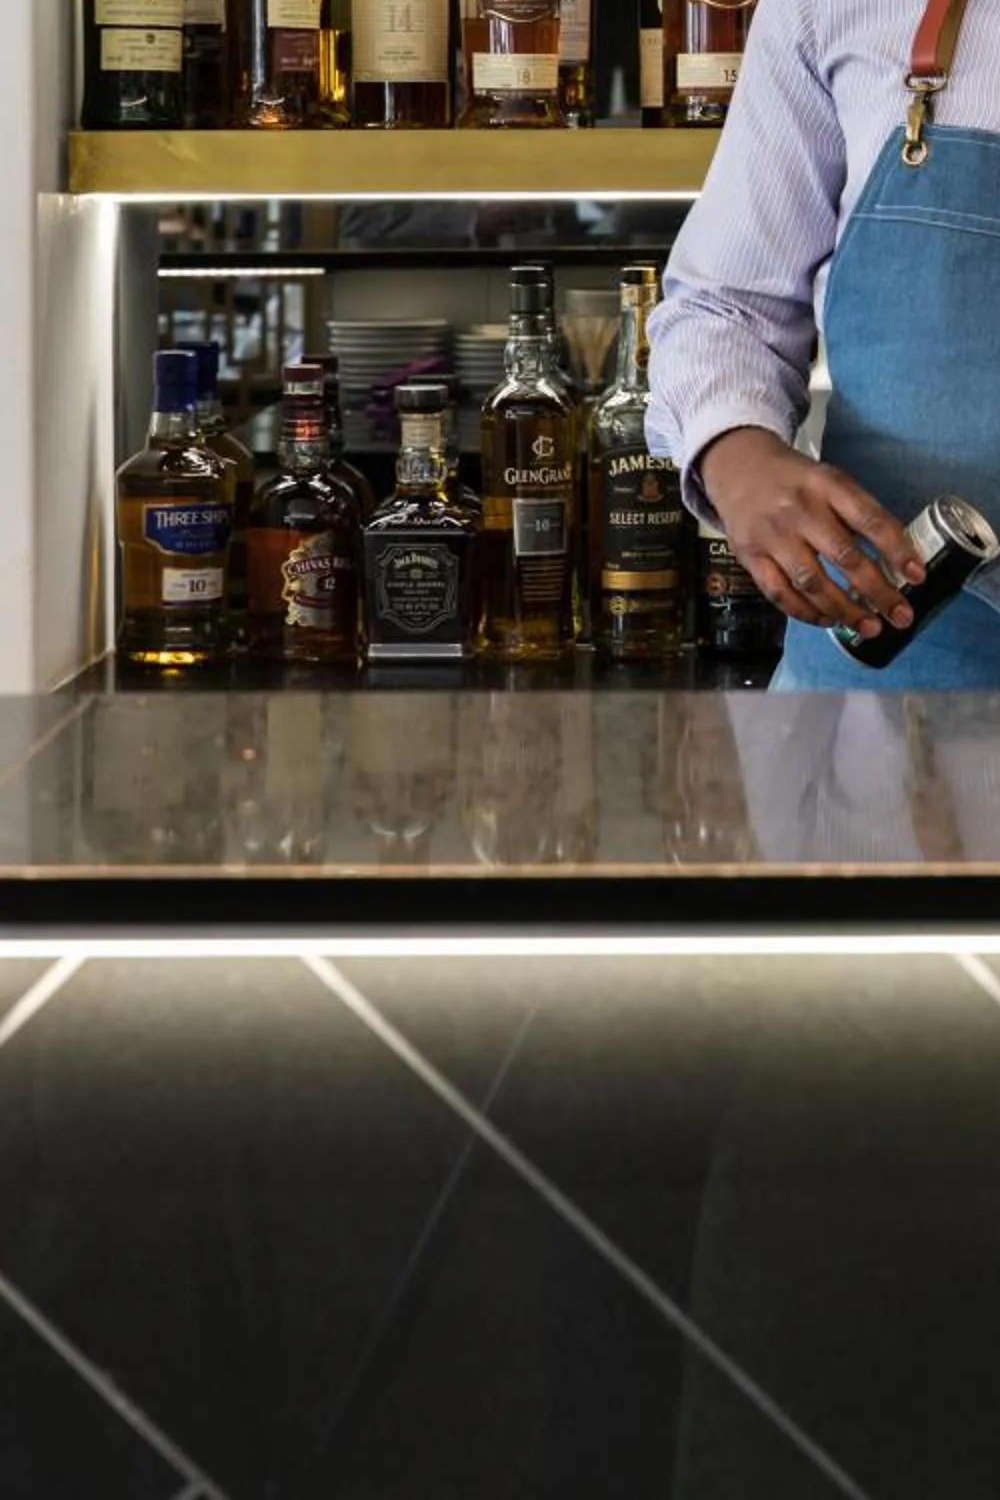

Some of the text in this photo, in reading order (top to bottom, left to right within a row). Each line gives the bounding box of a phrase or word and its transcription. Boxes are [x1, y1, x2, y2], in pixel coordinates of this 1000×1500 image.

[723, 69, 737, 83] 15
[608, 453, 676, 477] JAMESO
[152, 509, 199, 530] THREE
[609, 511, 645, 526] SELECT
[535, 519, 550, 533] 10
[709, 542, 736, 556] CA
[288, 557, 331, 575] CHIVAS
[188, 579, 207, 593] 10
